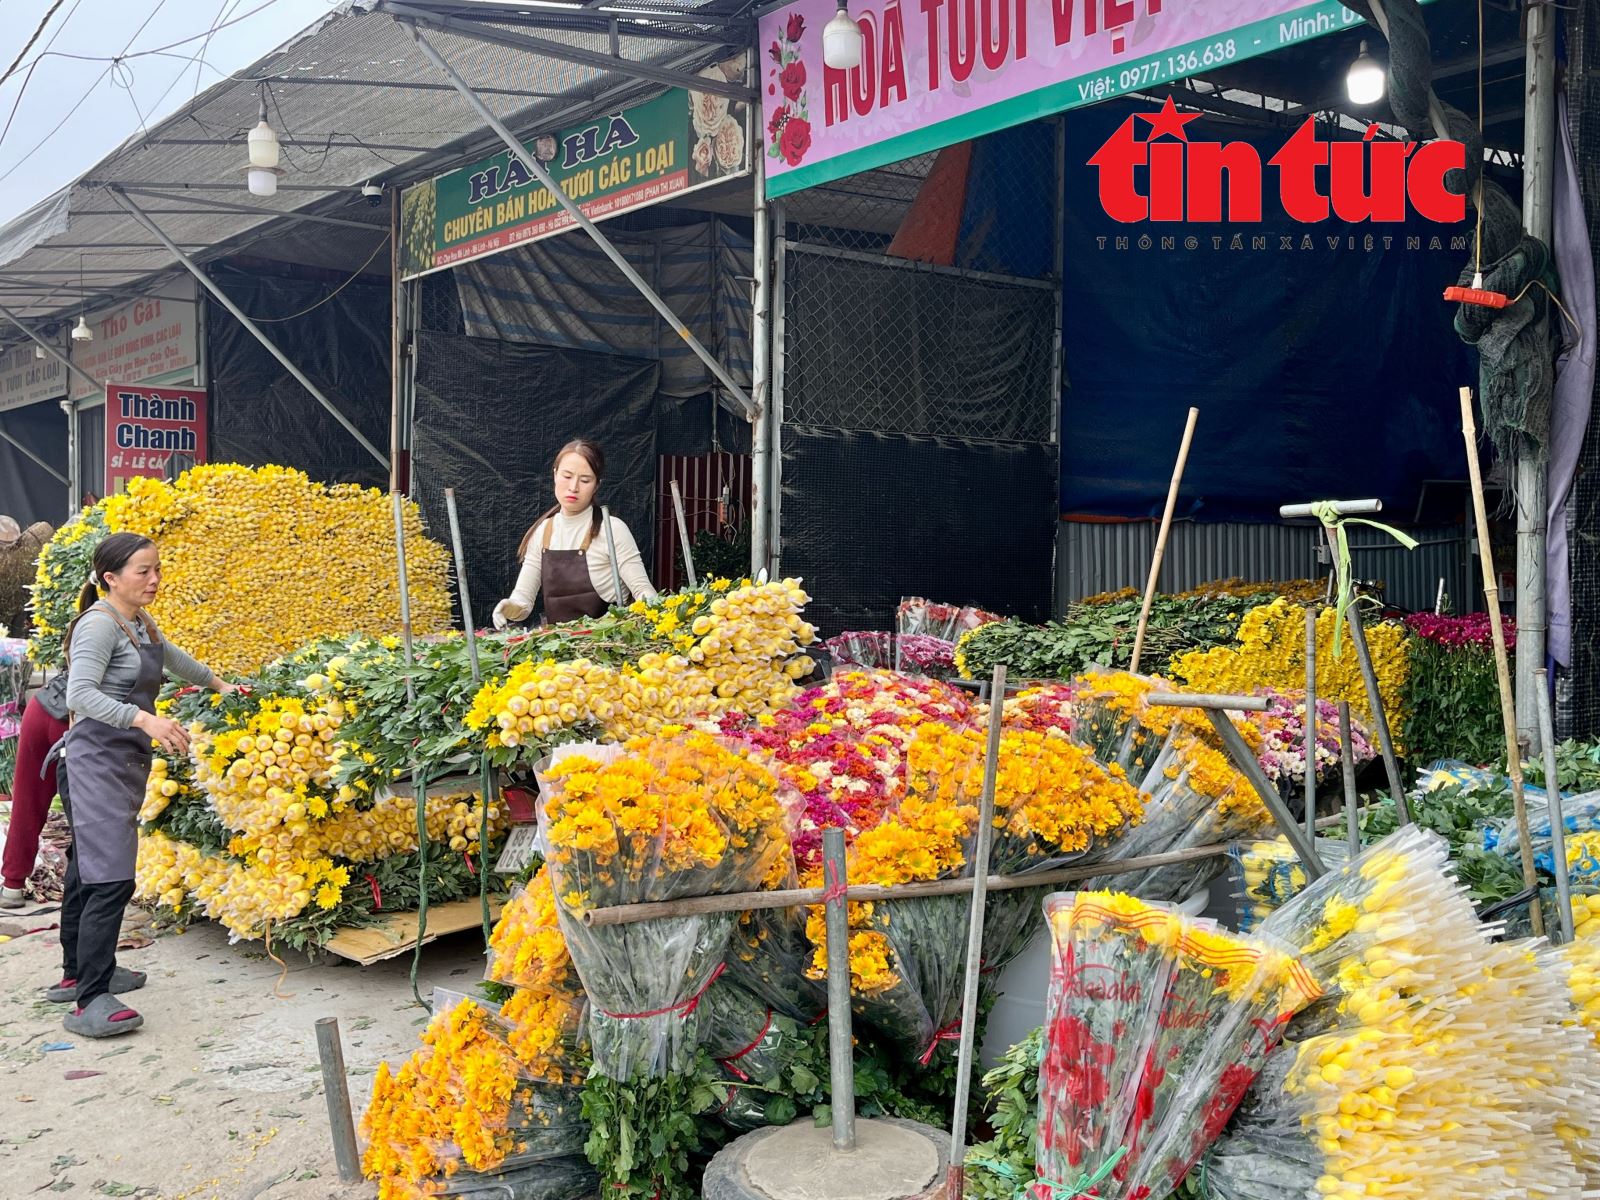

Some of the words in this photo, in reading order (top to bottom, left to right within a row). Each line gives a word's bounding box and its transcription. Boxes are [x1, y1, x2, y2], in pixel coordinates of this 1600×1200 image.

[1078, 76, 1115, 101] Việt:
[1120, 38, 1237, 90] 0977.136.638
[1279, 11, 1335, 43] Minh:
[444, 206, 493, 243] CHUYÊN
[497, 194, 525, 226] BÁN
[528, 187, 557, 215] HOA
[560, 168, 594, 200] TƯƠI
[599, 156, 631, 190] CÁC
[636, 140, 674, 176] LOẠI
[118, 392, 196, 422] Thành
[116, 422, 197, 452] Chanh
[148, 454, 165, 470] CÁ
